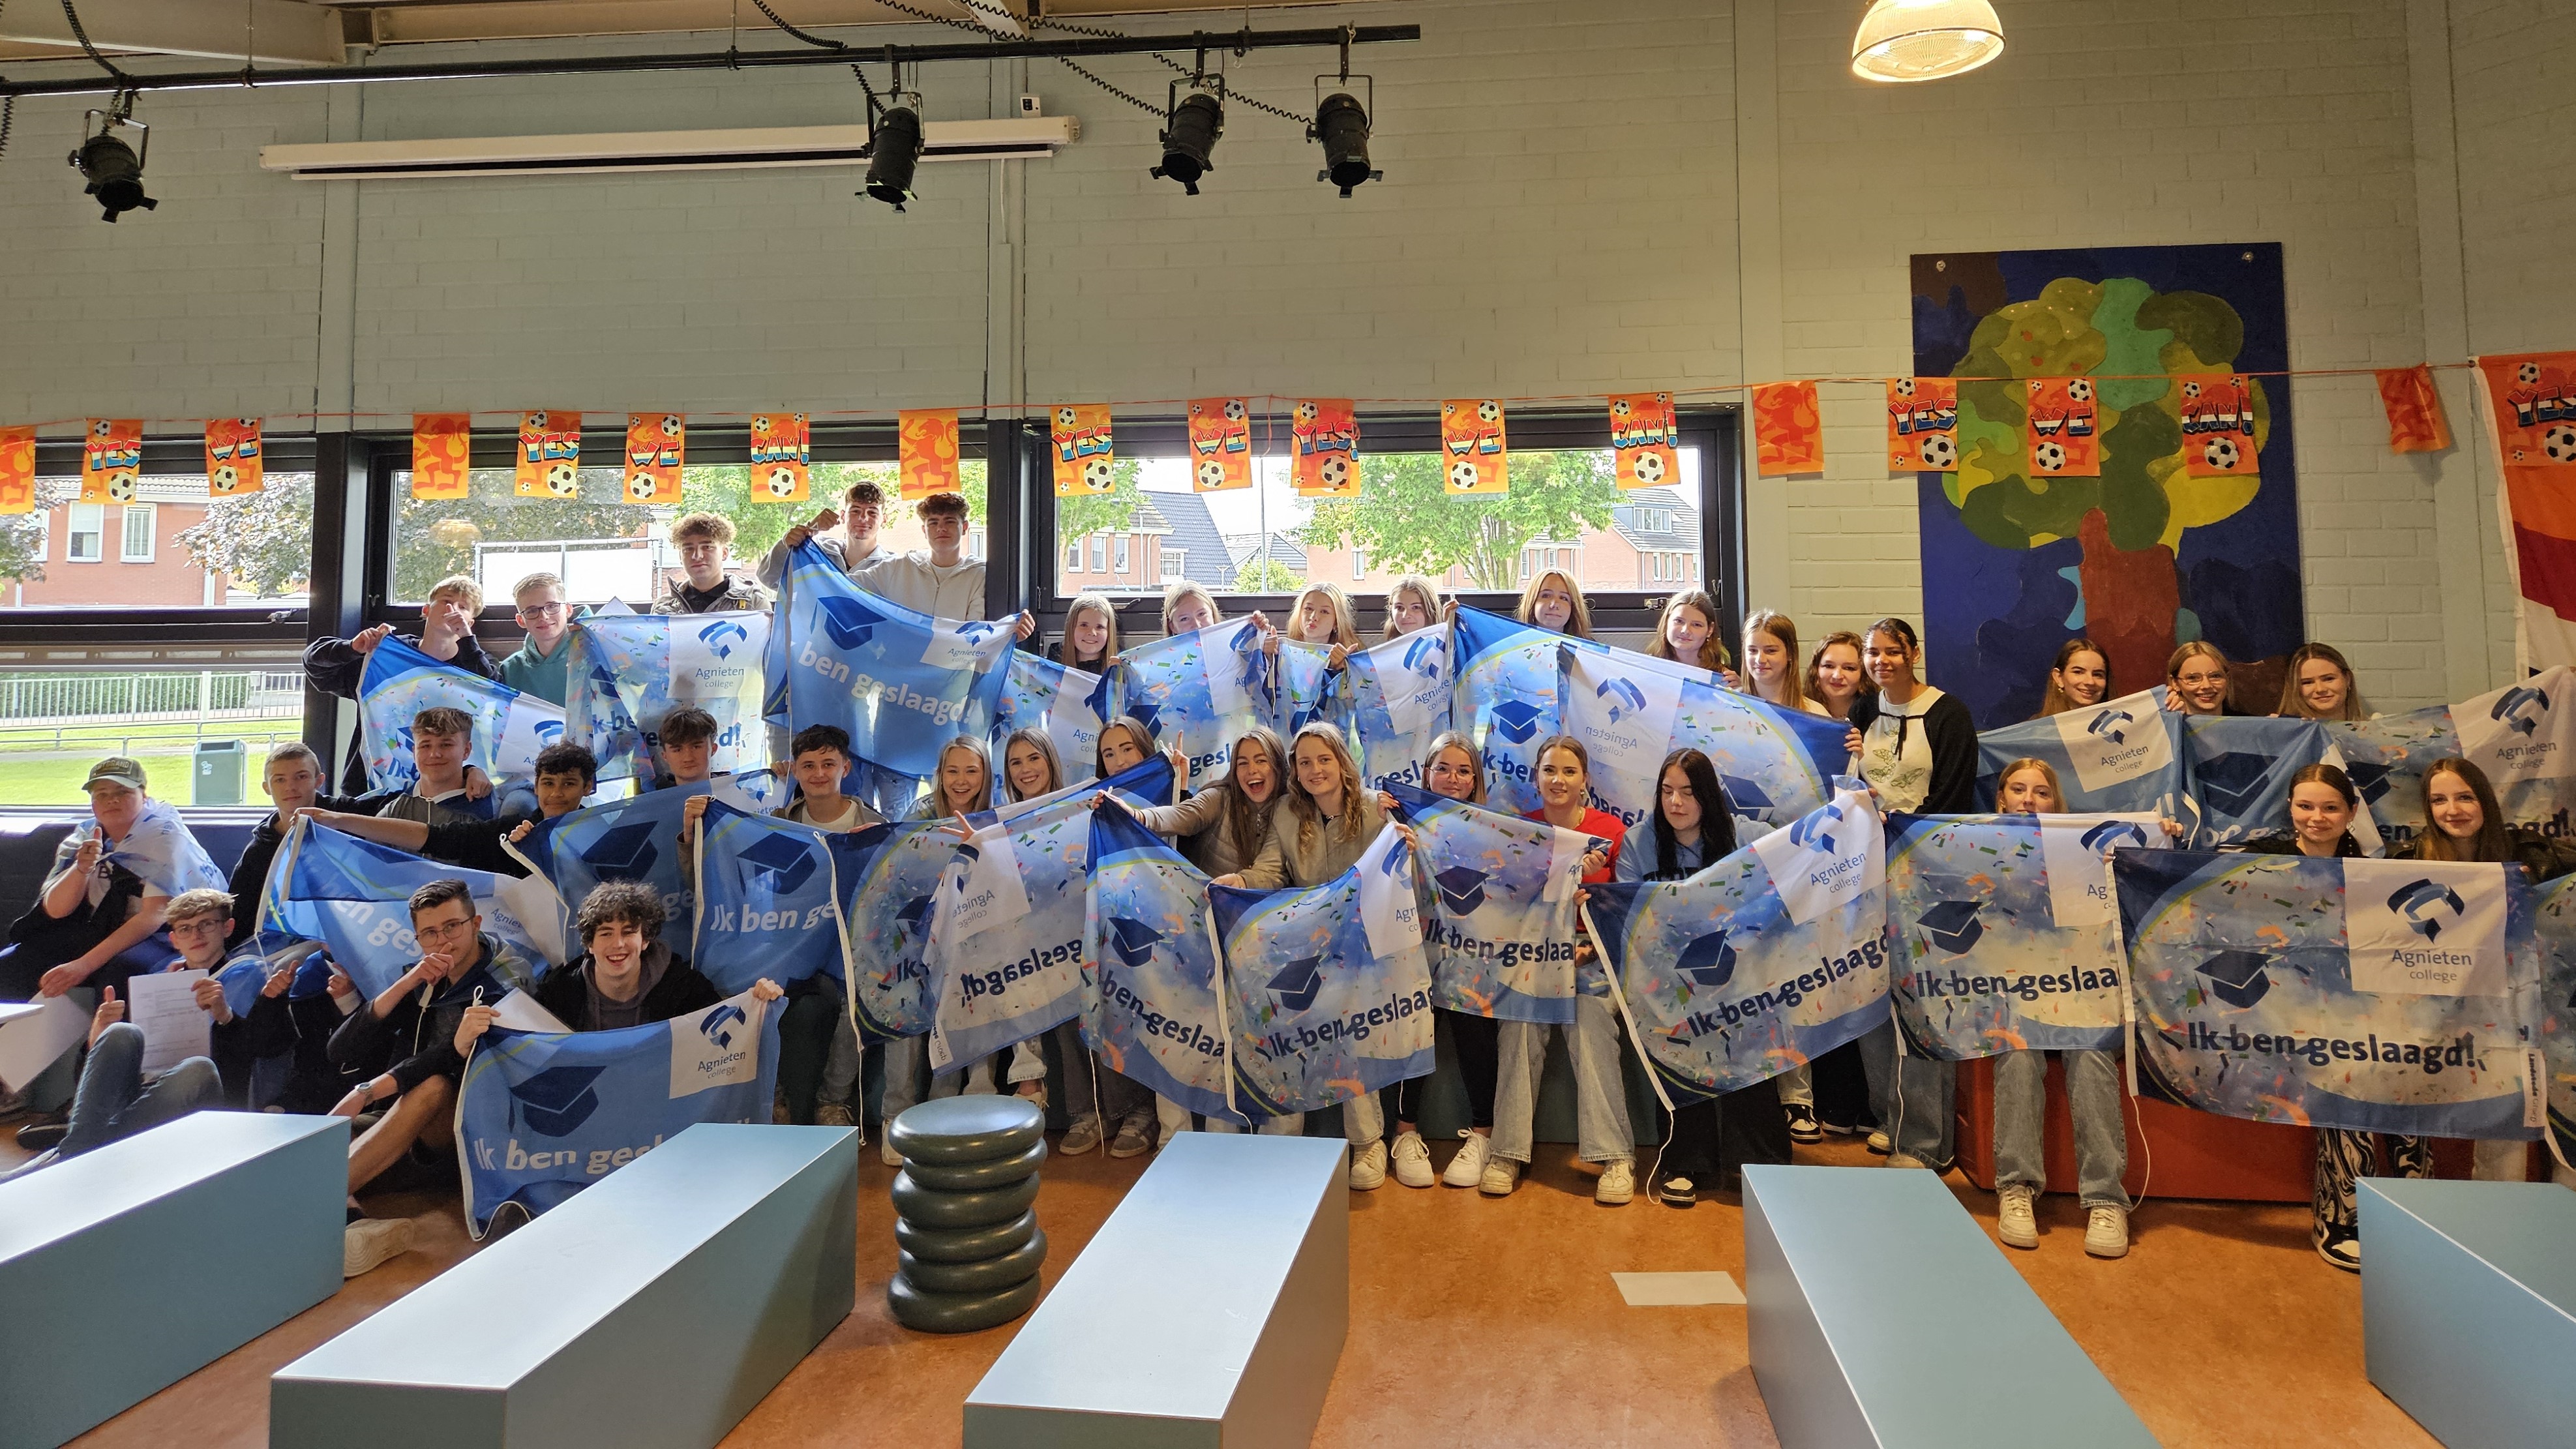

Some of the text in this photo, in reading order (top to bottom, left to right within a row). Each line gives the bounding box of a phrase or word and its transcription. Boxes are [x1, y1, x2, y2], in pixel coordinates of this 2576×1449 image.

[1889, 398, 1957, 436] YES
[2031, 406, 2092, 436] WE
[2181, 395, 2254, 436] CAN!
[2507, 384, 2576, 427] YES
[209, 430, 259, 462] WE
[1052, 425, 1113, 464] YES
[1192, 425, 1246, 456] WE
[1446, 426, 1501, 456] WE
[1611, 410, 1678, 451] CAN!
[85, 439, 141, 471] YES
[519, 430, 581, 463] YES
[629, 440, 680, 467] WE
[751, 429, 809, 466] CAN!
[695, 667, 744, 680] Agnieten
[705, 680, 734, 689] college
[798, 640, 976, 726] ben geslaagd!
[1415, 679, 1449, 704] Agniete
[1073, 729, 1099, 743] Agni
[1081, 744, 1098, 753] coll
[2496, 742, 2556, 760] Agnieten
[2101, 746, 2149, 766] Agnieten
[2115, 759, 2143, 773] college
[1811, 853, 1866, 886] Agnieten
[1829, 874, 1861, 893] college
[710, 904, 735, 932] Ik
[741, 904, 798, 933] ben
[1425, 919, 1574, 967] Ik ben geslaa
[2391, 949, 2472, 967] Agnieten
[1686, 924, 1889, 1038] Ik ben geslaagd
[1916, 966, 2119, 1001] Ik ben geslaa
[2410, 970, 2457, 983] college
[1102, 970, 1225, 1056] ben geslaa
[1268, 1032, 1295, 1056] Ik
[1297, 1019, 1346, 1047] ben
[2188, 1021, 2476, 1074] Ik ben geslaagd!
[698, 1051, 745, 1072] Agnieten
[708, 1066, 736, 1079] college
[474, 1138, 496, 1171] Ik
[505, 1139, 577, 1171] ben
